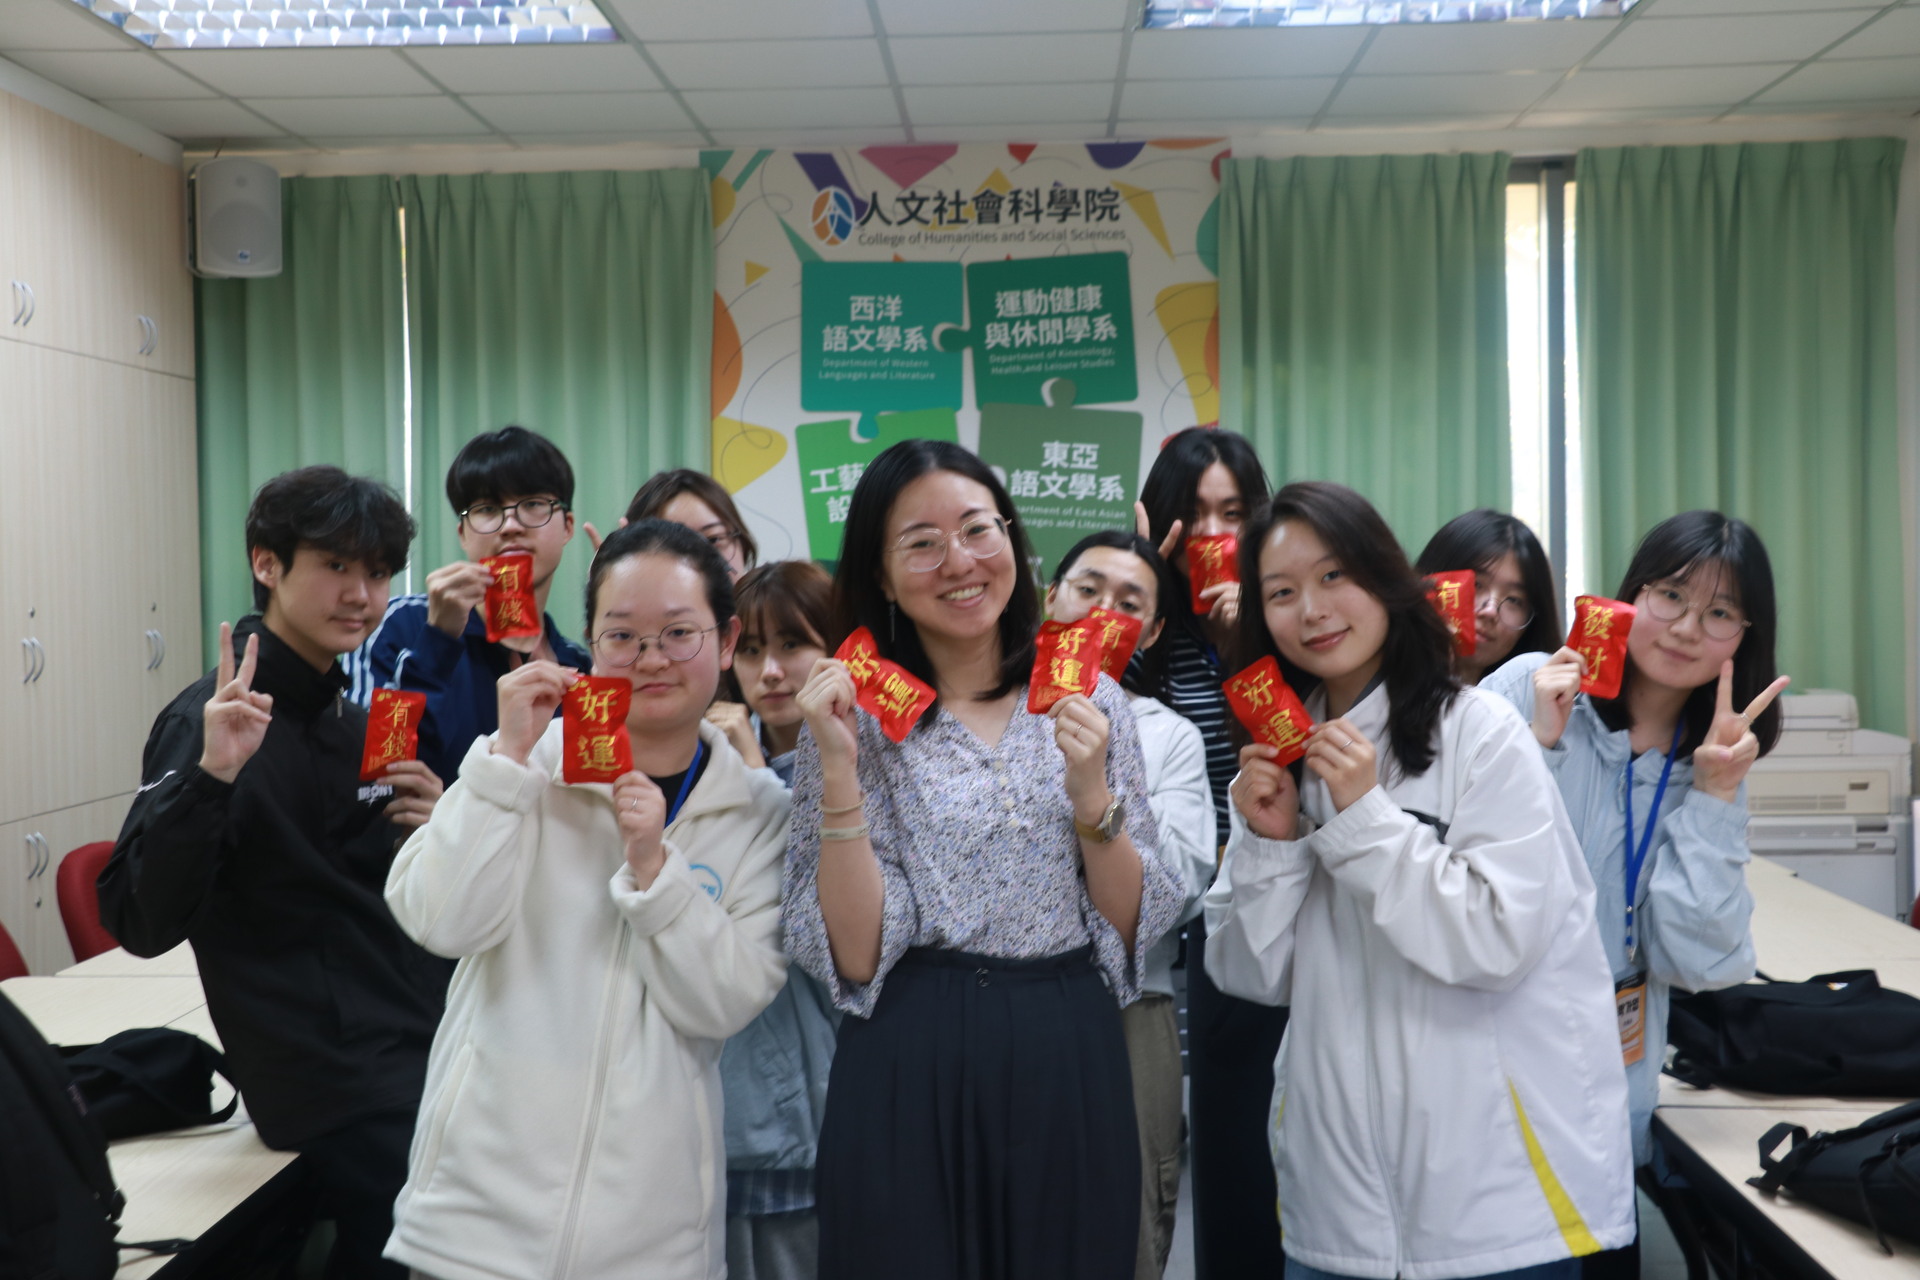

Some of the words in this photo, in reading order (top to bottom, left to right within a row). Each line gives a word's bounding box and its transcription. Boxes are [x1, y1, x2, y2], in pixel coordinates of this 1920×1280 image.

[858, 186, 1121, 228] 人文社會科學院
[858, 232, 905, 247] College
[908, 231, 922, 244] of
[925, 230, 998, 244] Humanities
[1001, 229, 1025, 242] and
[1028, 229, 1067, 242] Social
[1070, 228, 1126, 241] Sciences
[849, 294, 903, 322] 西洋
[995, 284, 1102, 318] 運動健康
[822, 324, 928, 352] 語文學系
[822, 358, 877, 369] Department
[880, 358, 890, 368] of
[891, 359, 930, 368] Western
[989, 351, 1044, 364] Department
[1047, 349, 1057, 359] of
[818, 371, 868, 382] Languages
[870, 371, 888, 380] and
[890, 371, 936, 380] Literature
[1041, 440, 1099, 470] 東亞
[1009, 468, 1125, 502] 語文學系
[1016, 504, 1059, 516] artment
[1062, 506, 1073, 517] of
[1075, 507, 1097, 518] East
[1098, 509, 1126, 519] Asian
[1056, 518, 1075, 528] and
[577, 687, 622, 772] 好運
